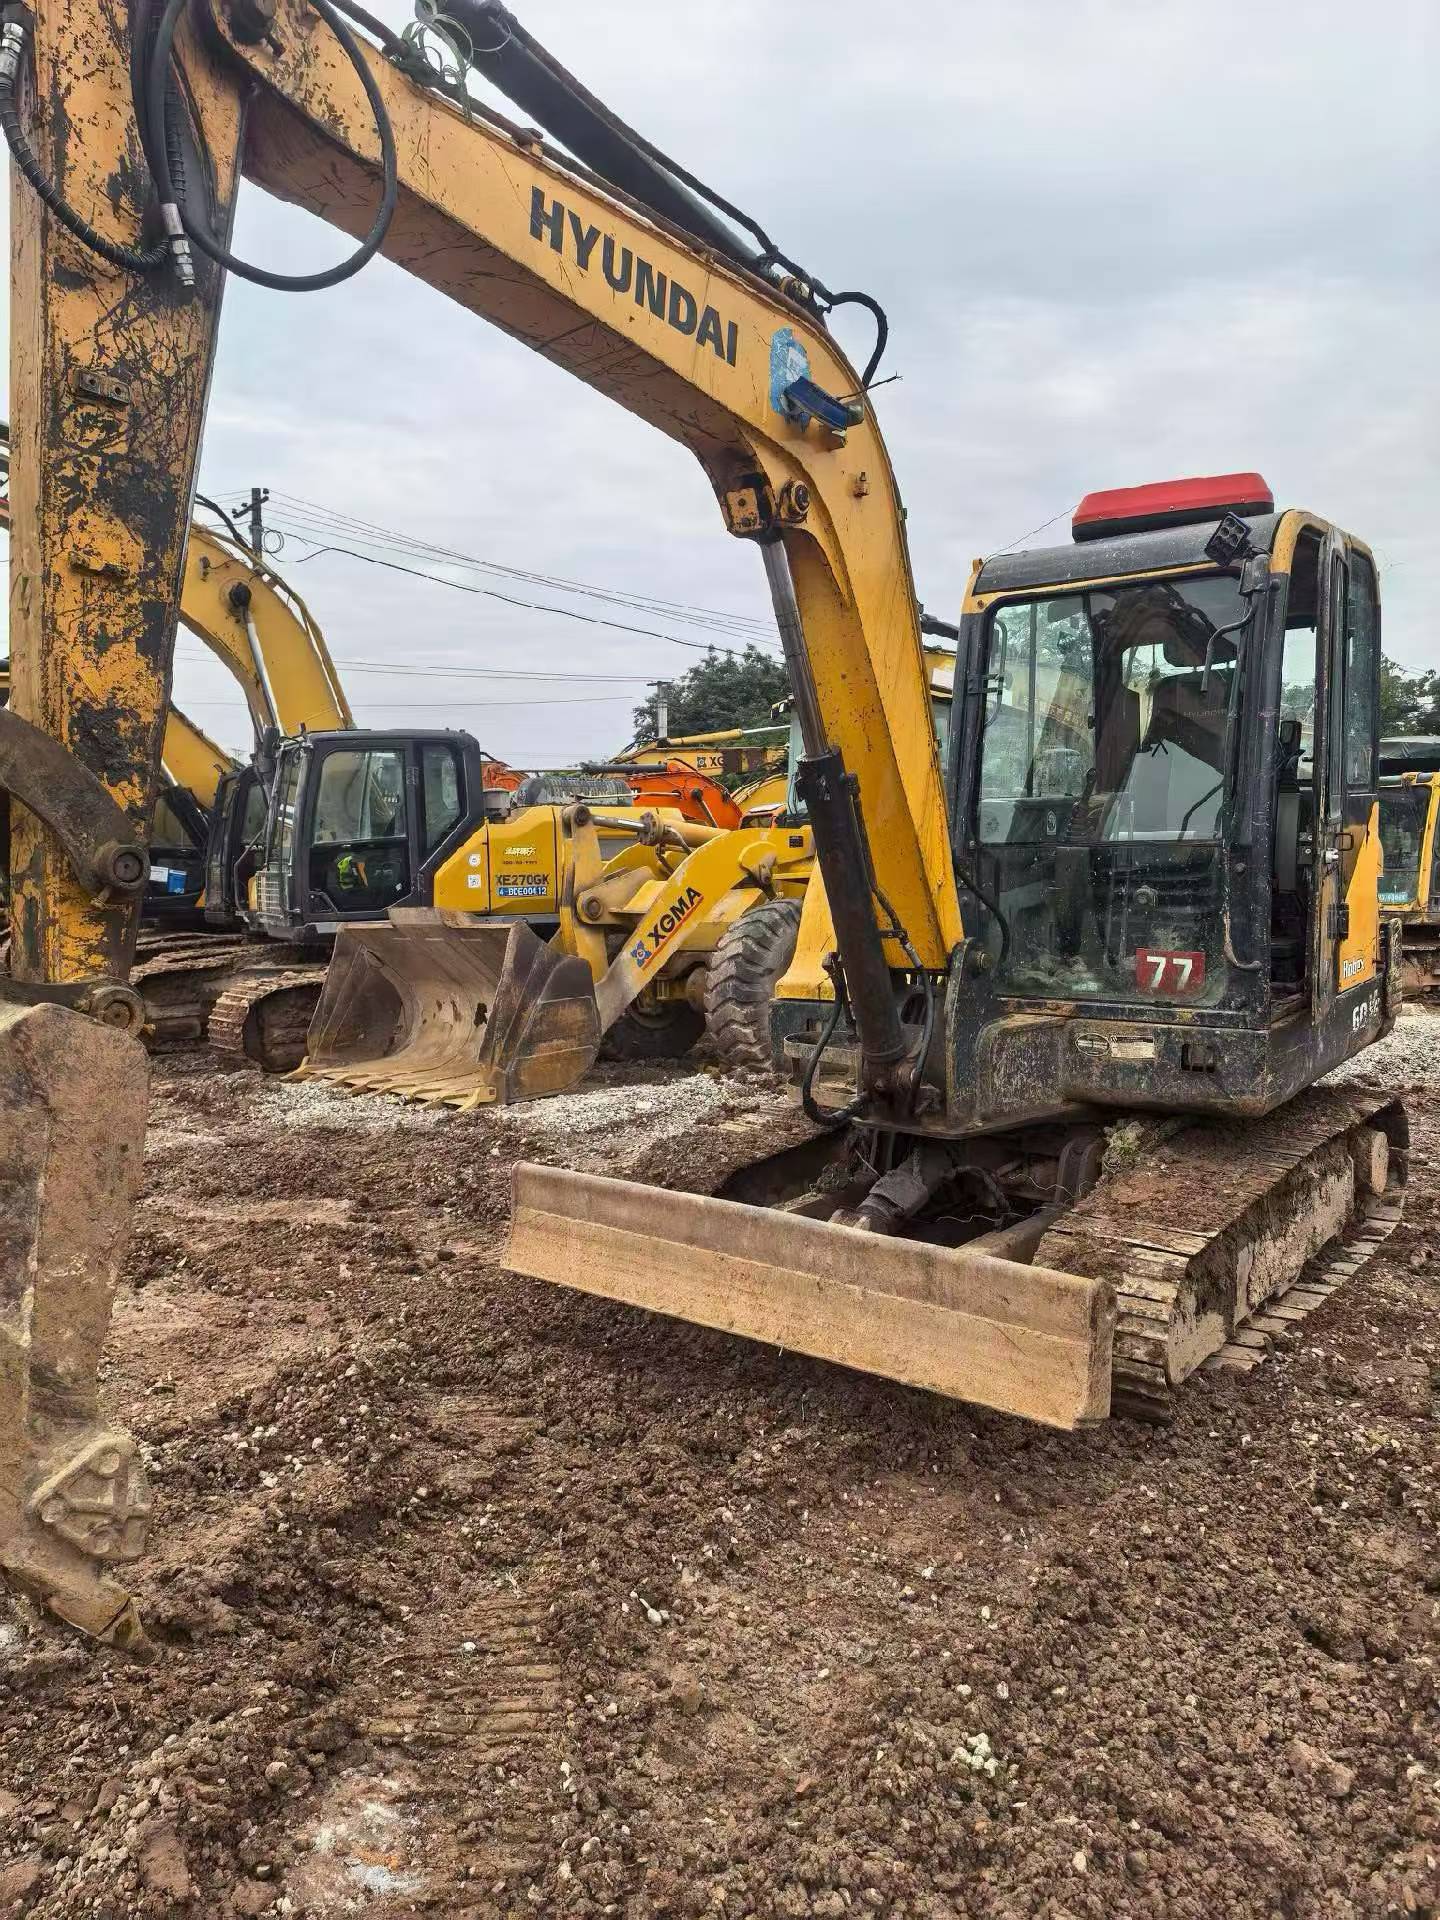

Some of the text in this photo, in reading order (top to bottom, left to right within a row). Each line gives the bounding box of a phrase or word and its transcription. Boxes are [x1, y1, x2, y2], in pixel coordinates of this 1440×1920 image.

[529, 184, 739, 368] HYUNDAI
[647, 886, 702, 949] XGMA
[1146, 955, 1193, 991] 77
